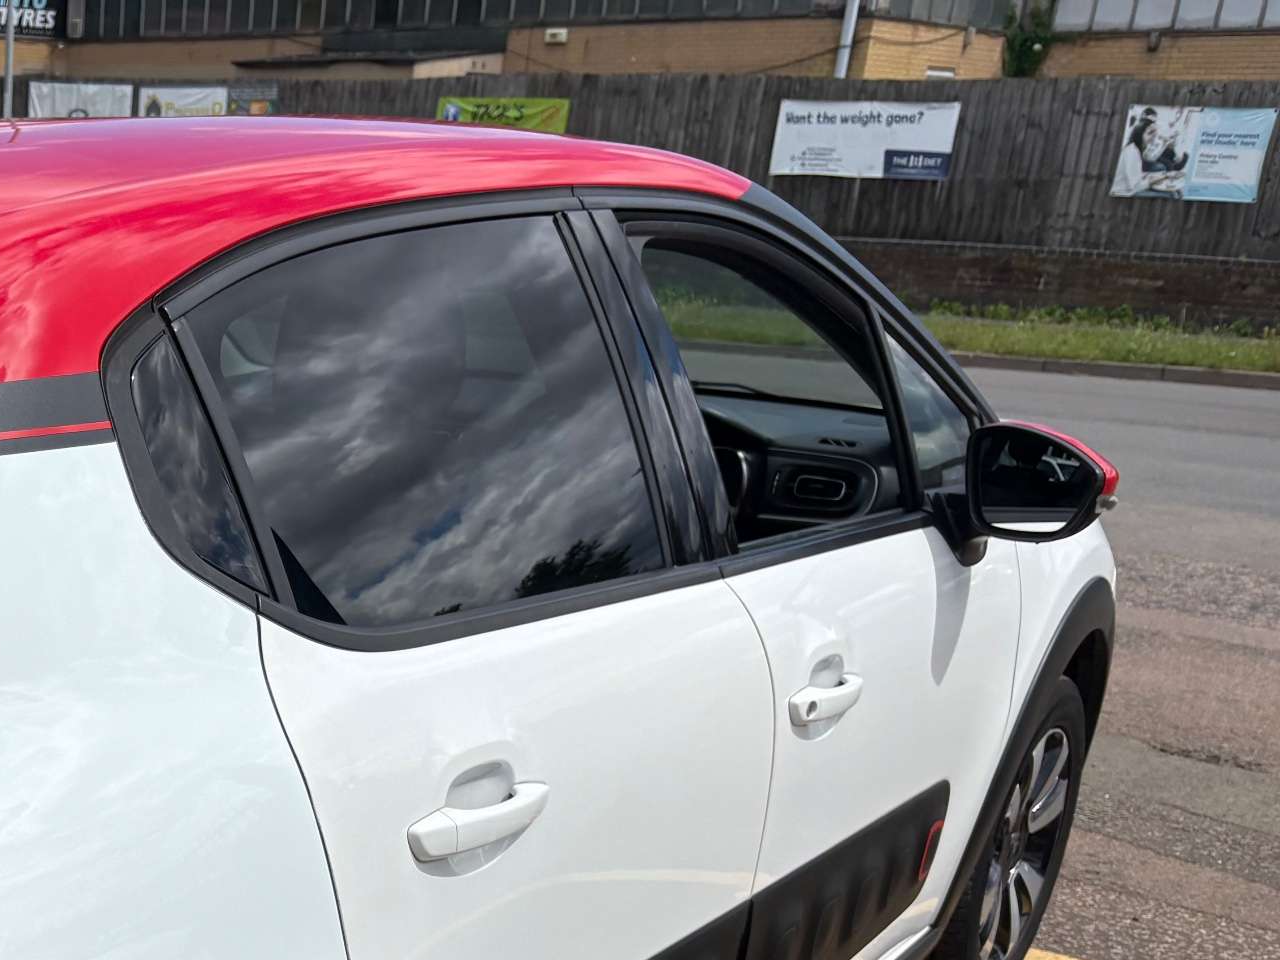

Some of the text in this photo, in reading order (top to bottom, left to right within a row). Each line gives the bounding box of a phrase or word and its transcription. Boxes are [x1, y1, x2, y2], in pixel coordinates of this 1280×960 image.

[0, 7, 57, 29] TYRES
[786, 111, 925, 127] Want the weight gone?
